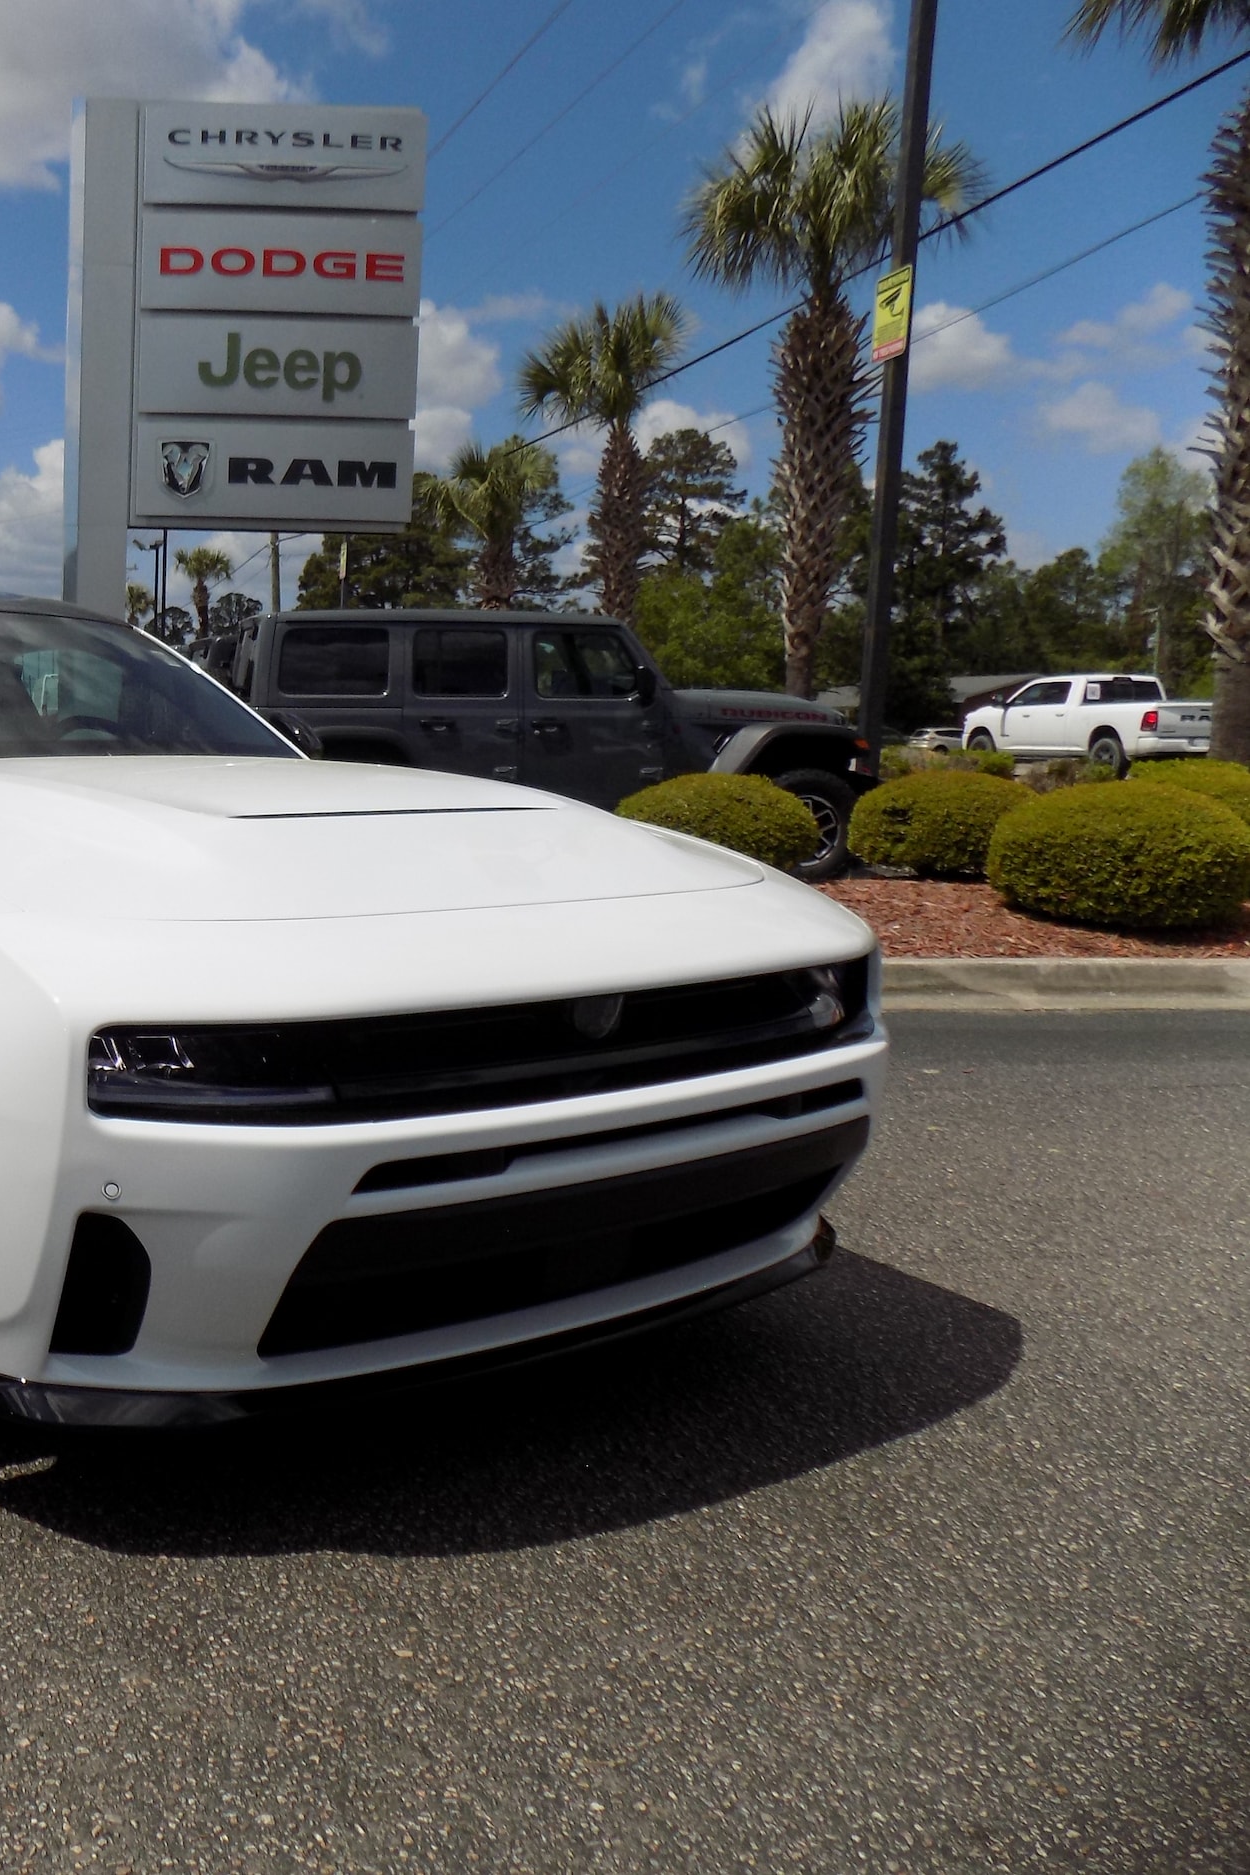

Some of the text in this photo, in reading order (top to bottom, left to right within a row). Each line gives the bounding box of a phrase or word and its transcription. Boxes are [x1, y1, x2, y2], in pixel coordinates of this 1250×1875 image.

[167, 129, 404, 152] CHRYSLER
[159, 247, 405, 282] DODGE
[198, 332, 363, 403] Jeep
[228, 457, 397, 489] RAM
[720, 707, 828, 721] RUBICON
